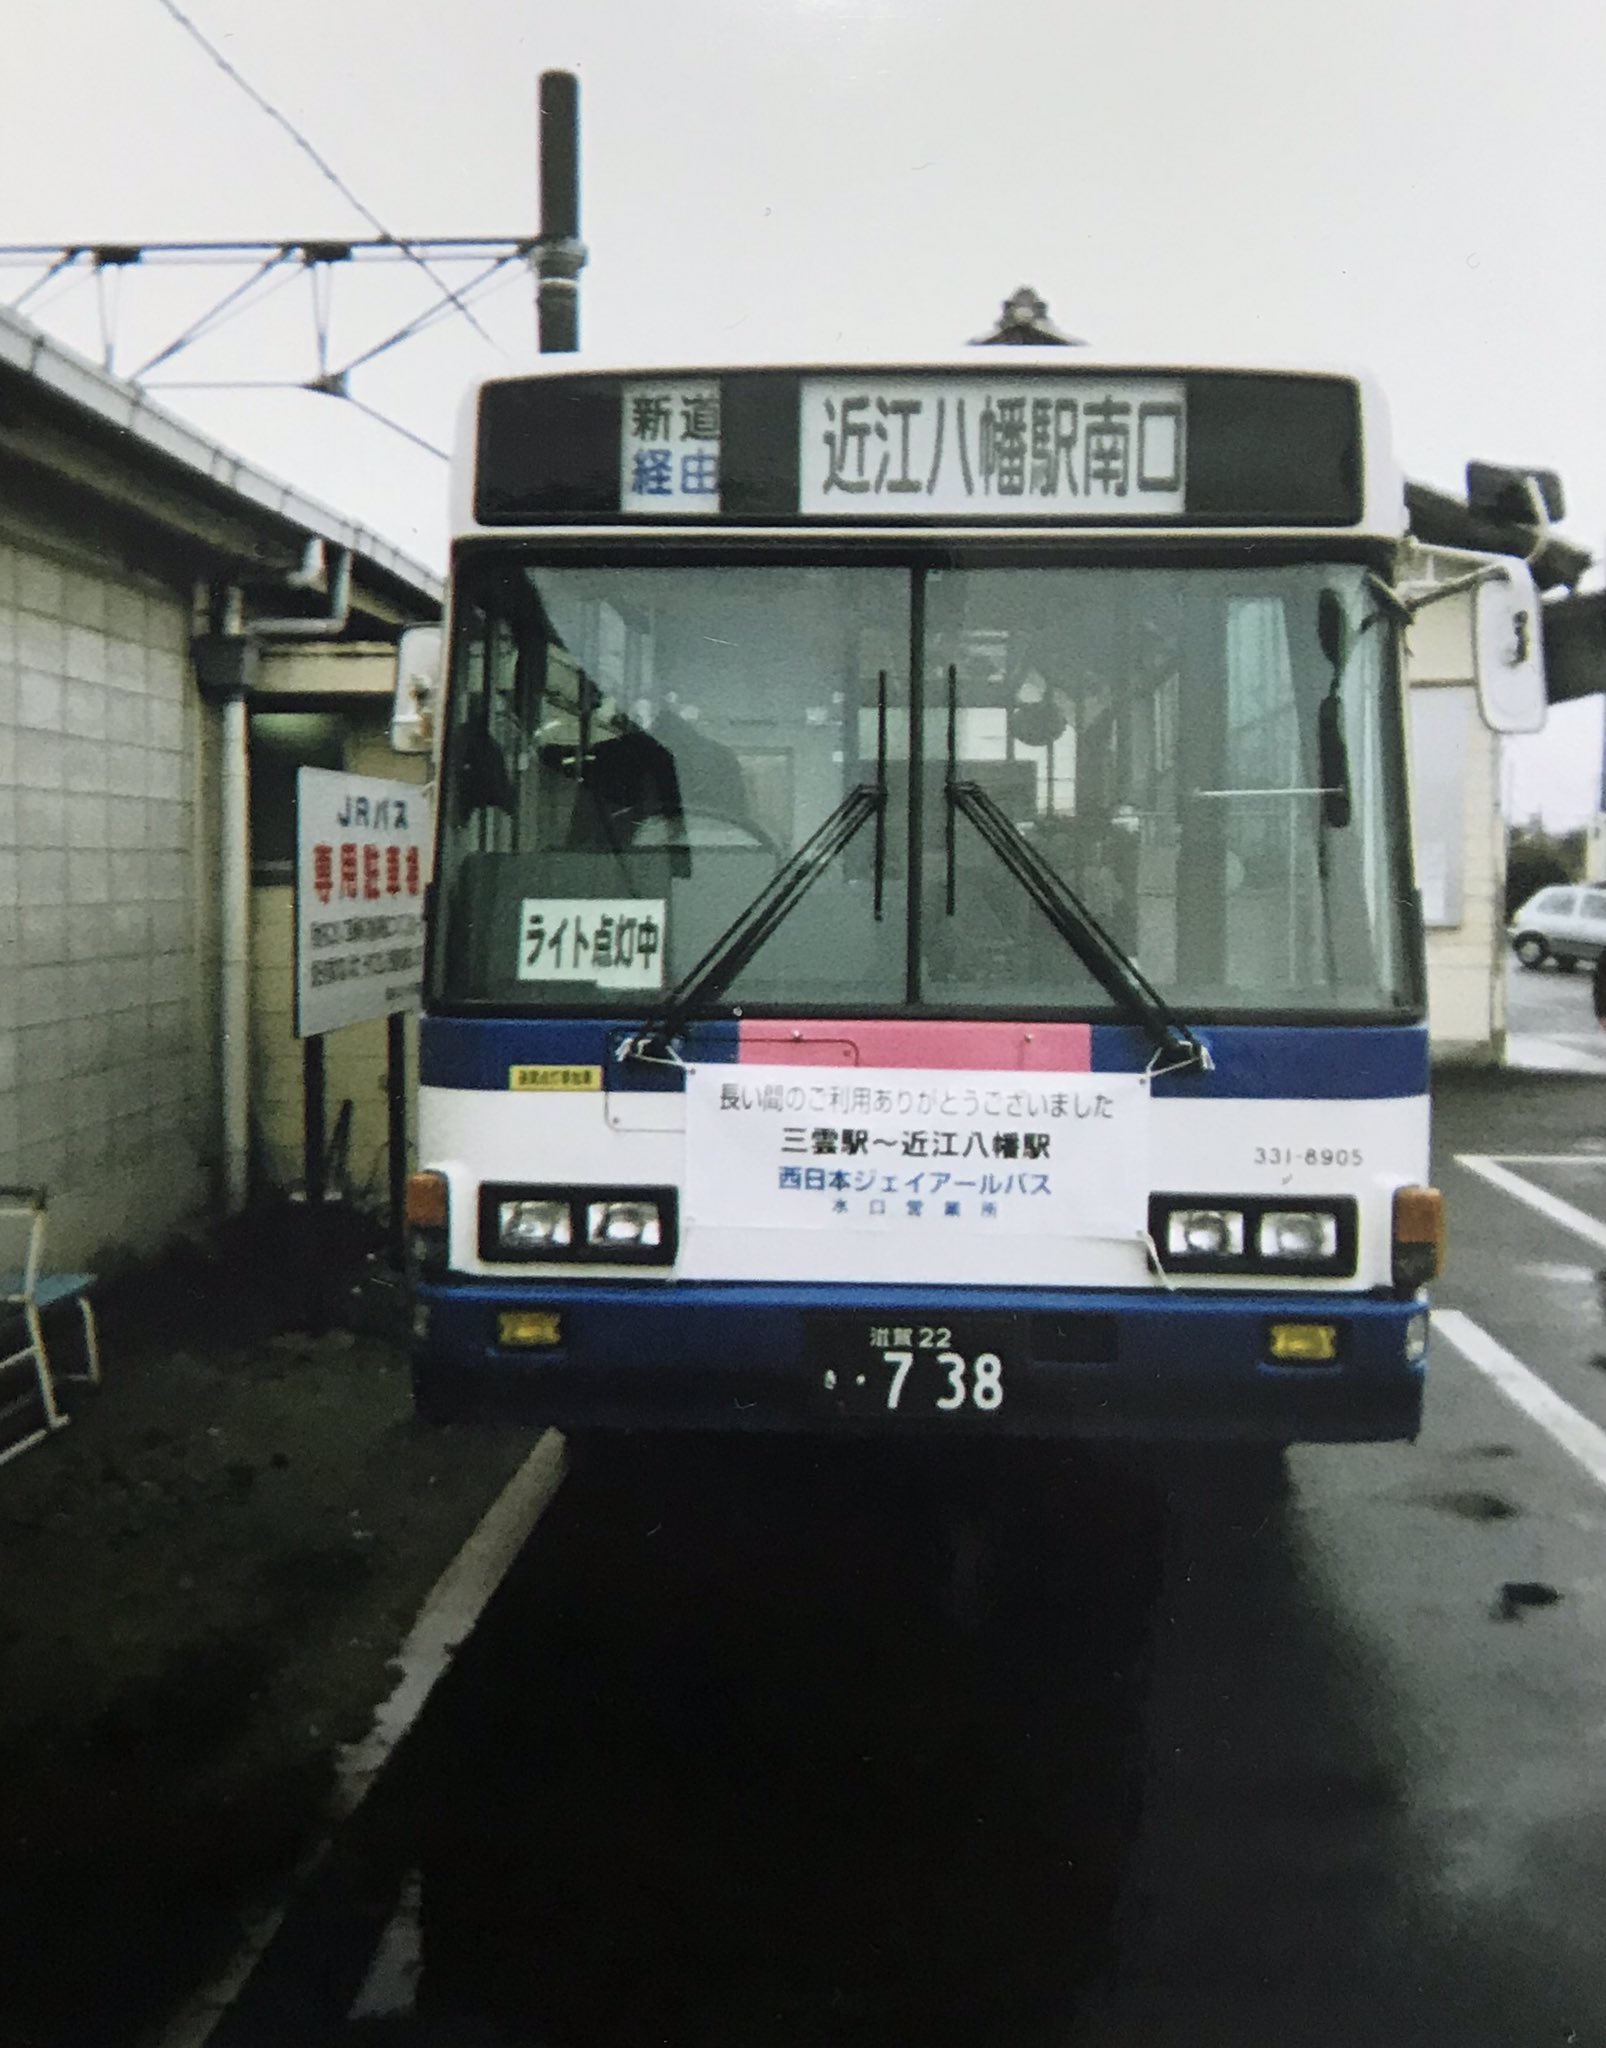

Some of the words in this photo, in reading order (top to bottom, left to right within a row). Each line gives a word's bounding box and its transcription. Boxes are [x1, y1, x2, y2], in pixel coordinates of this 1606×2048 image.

[632, 393, 721, 441] 新道
[823, 394, 1182, 497] 近江八幡駅南口
[631, 448, 721, 495] 経由
[337, 796, 409, 830] JRバス
[526, 913, 659, 970] ライト点灯中
[1254, 1146, 1363, 1166] 331-8905
[778, 1165, 1052, 1196] 西日本ジェイアールバス
[919, 1327, 951, 1348] 22
